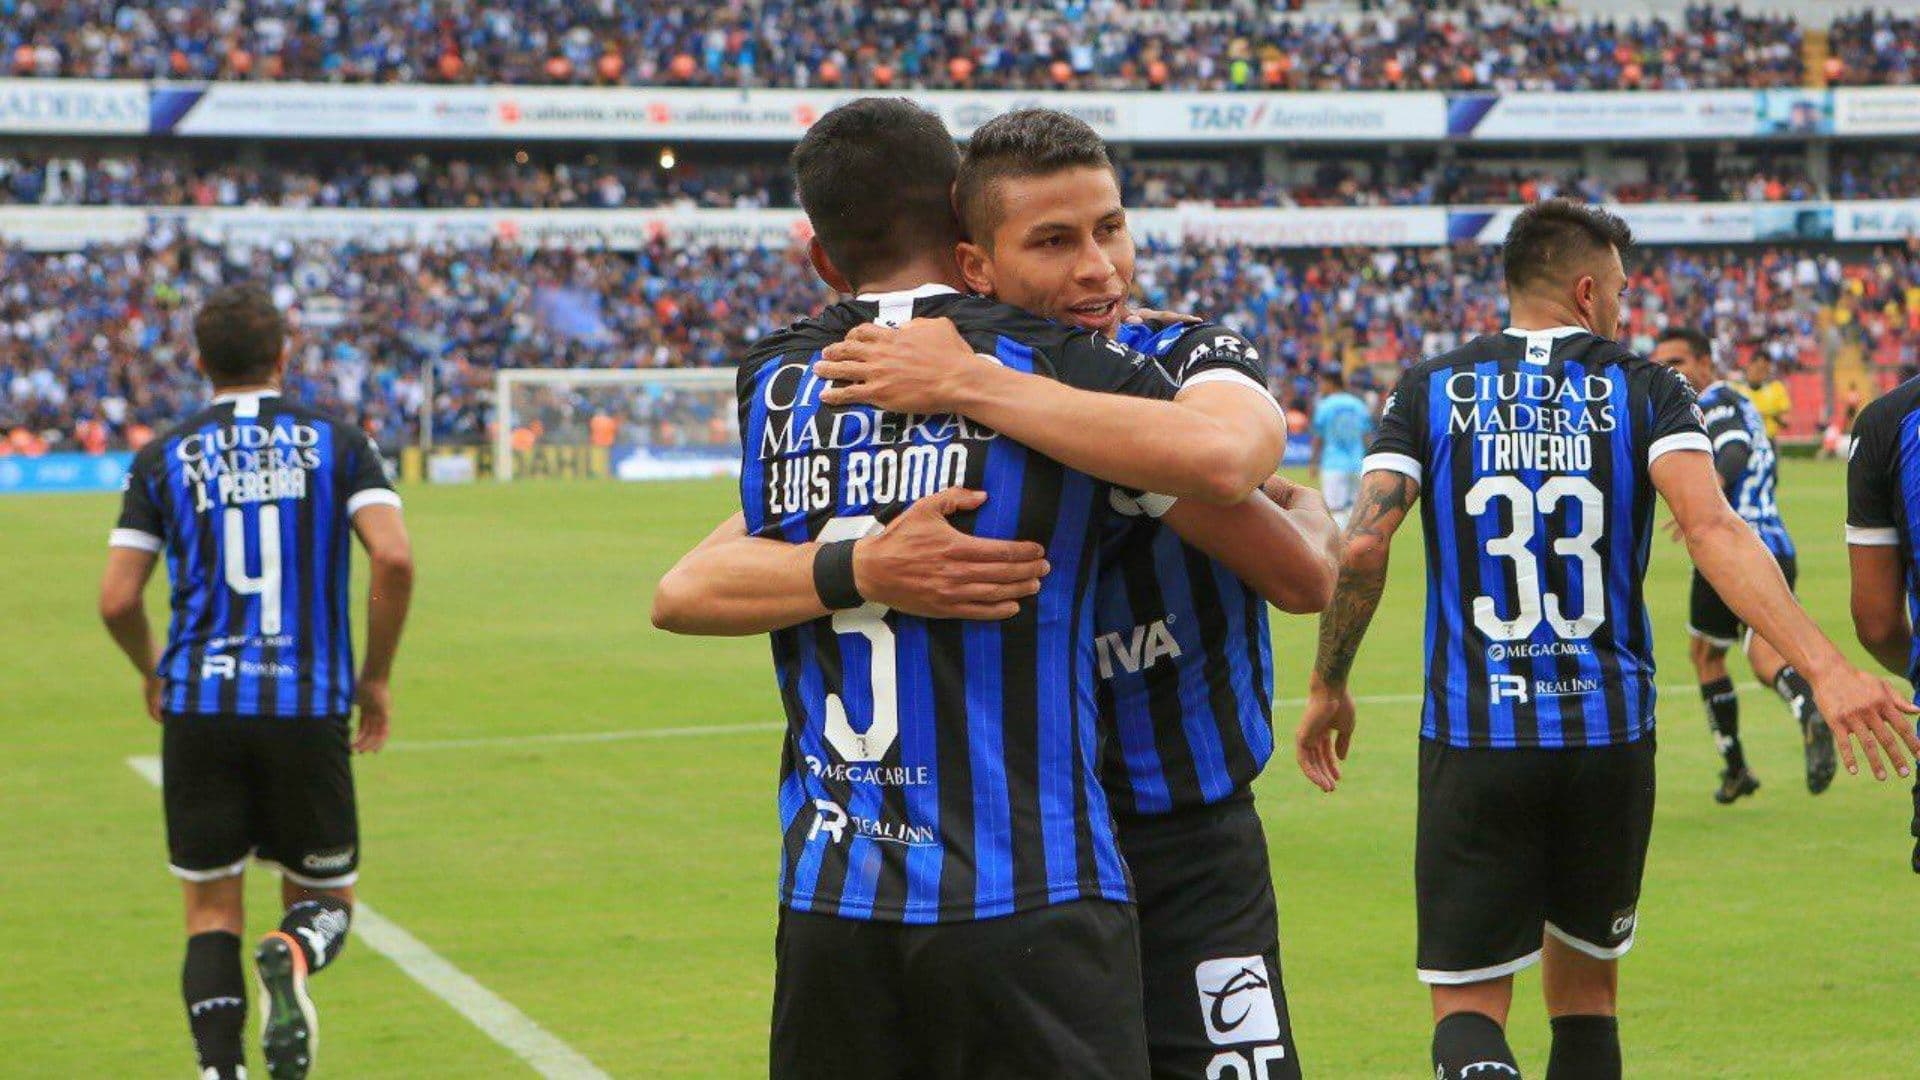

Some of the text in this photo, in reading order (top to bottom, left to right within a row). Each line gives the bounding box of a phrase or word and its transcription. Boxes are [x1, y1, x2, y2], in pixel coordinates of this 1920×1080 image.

[1187, 105, 1247, 129] TAR
[1445, 371, 1614, 403] CIUDAD
[1446, 402, 1616, 434] MADERAS
[176, 425, 320, 462] CIUDAD
[1477, 433, 1593, 472] TRIVERIO
[182, 447, 322, 485] MADERAS
[768, 443, 969, 514] LUIS ROMO
[223, 504, 282, 635] 4
[1465, 475, 1606, 641] 33
